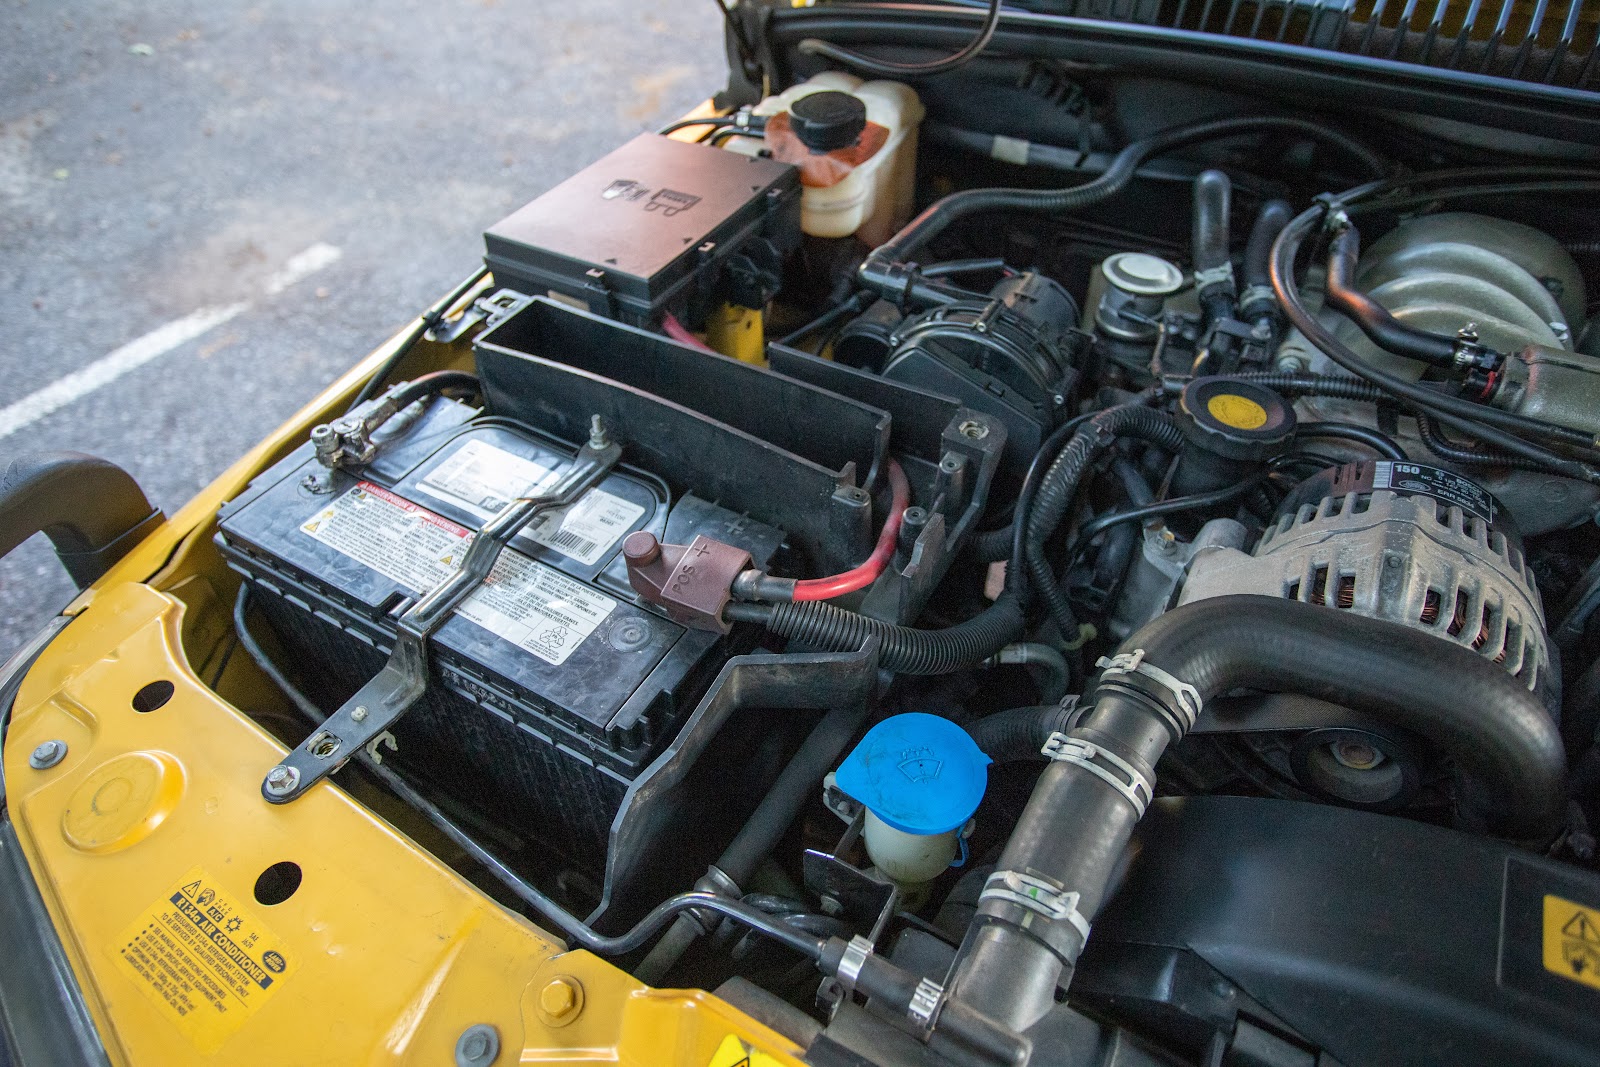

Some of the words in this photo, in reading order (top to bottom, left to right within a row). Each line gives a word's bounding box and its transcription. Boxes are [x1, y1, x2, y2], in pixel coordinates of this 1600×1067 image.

[1395, 465, 1419, 475] 150
[1456, 478, 1481, 494] BOSCH
[671, 564, 695, 593] POS
[207, 907, 223, 921] A/C
[157, 933, 177, 951] MANUAL
[173, 947, 185, 958] FOR
[181, 955, 204, 976] SERVICING
[170, 911, 197, 936] PRESSURISED
[206, 944, 235, 972] REFRIGERANT
[232, 969, 251, 986] SYSTEM
[174, 896, 204, 923] R134a
[197, 918, 217, 936] AIR
[211, 930, 268, 983] CONDITIONER
[248, 932, 259, 942] SAE
[164, 917, 174, 926] BE
[169, 922, 190, 942] SERVICED
[192, 944, 216, 965] QUALIFIED
[212, 962, 239, 987] PERSONNEL
[235, 983, 250, 998] ONLY
